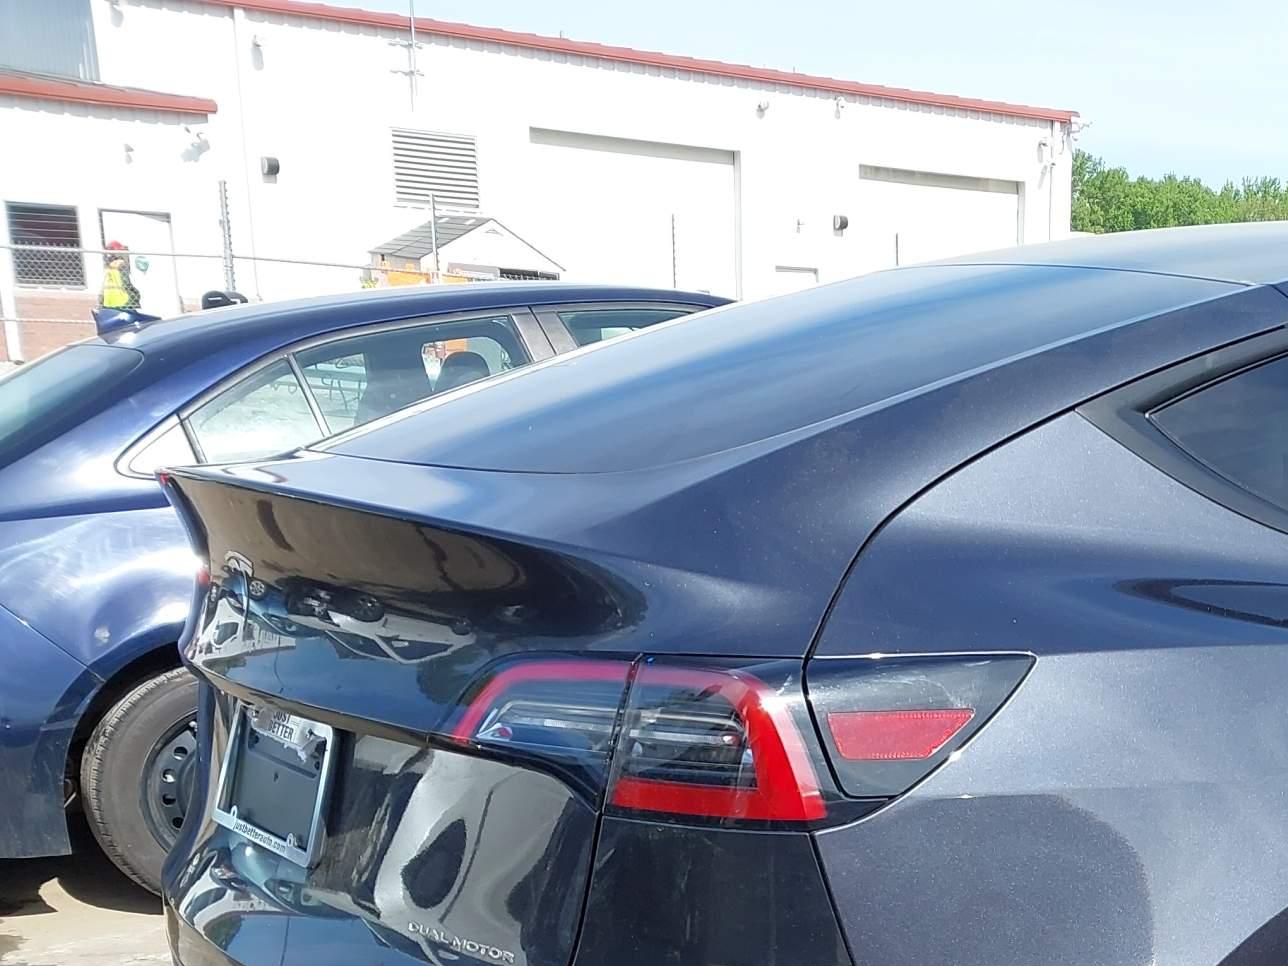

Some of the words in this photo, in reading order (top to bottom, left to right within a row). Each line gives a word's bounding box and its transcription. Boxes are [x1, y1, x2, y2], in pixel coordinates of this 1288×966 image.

[268, 719, 294, 742] BETTER
[274, 713, 290, 725] JUST
[232, 821, 286, 854] justbetterauto.com
[407, 921, 449, 944] DUAL
[450, 936, 515, 964] MOTOR
